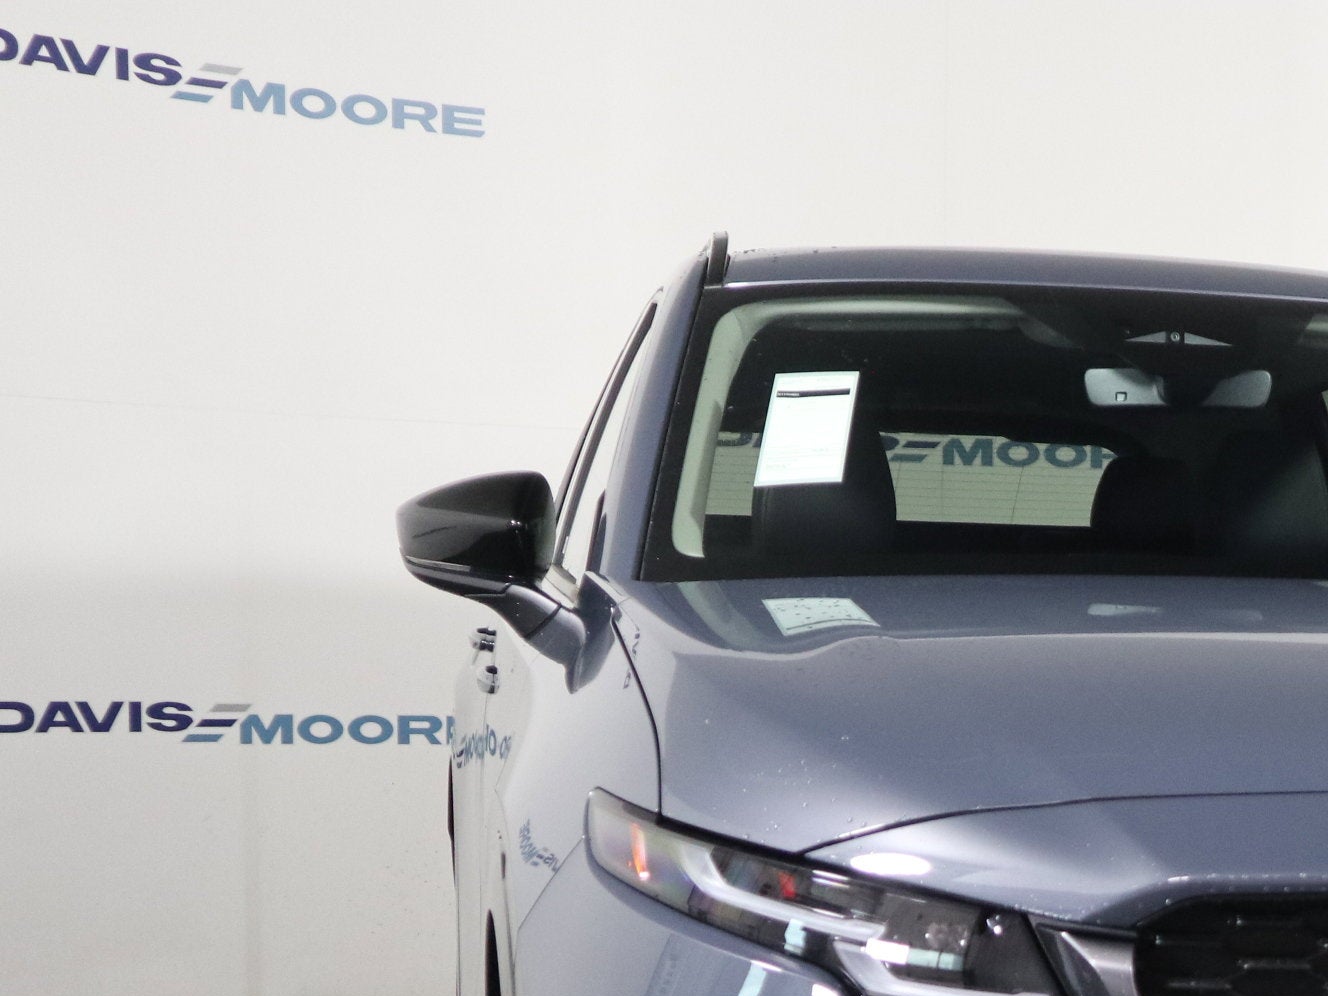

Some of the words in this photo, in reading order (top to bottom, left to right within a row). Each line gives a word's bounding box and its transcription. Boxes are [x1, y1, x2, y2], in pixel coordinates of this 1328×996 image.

[230, 78, 486, 138] MOORE
[0, 701, 194, 733] DAVIS
[239, 714, 455, 745] MOOR
